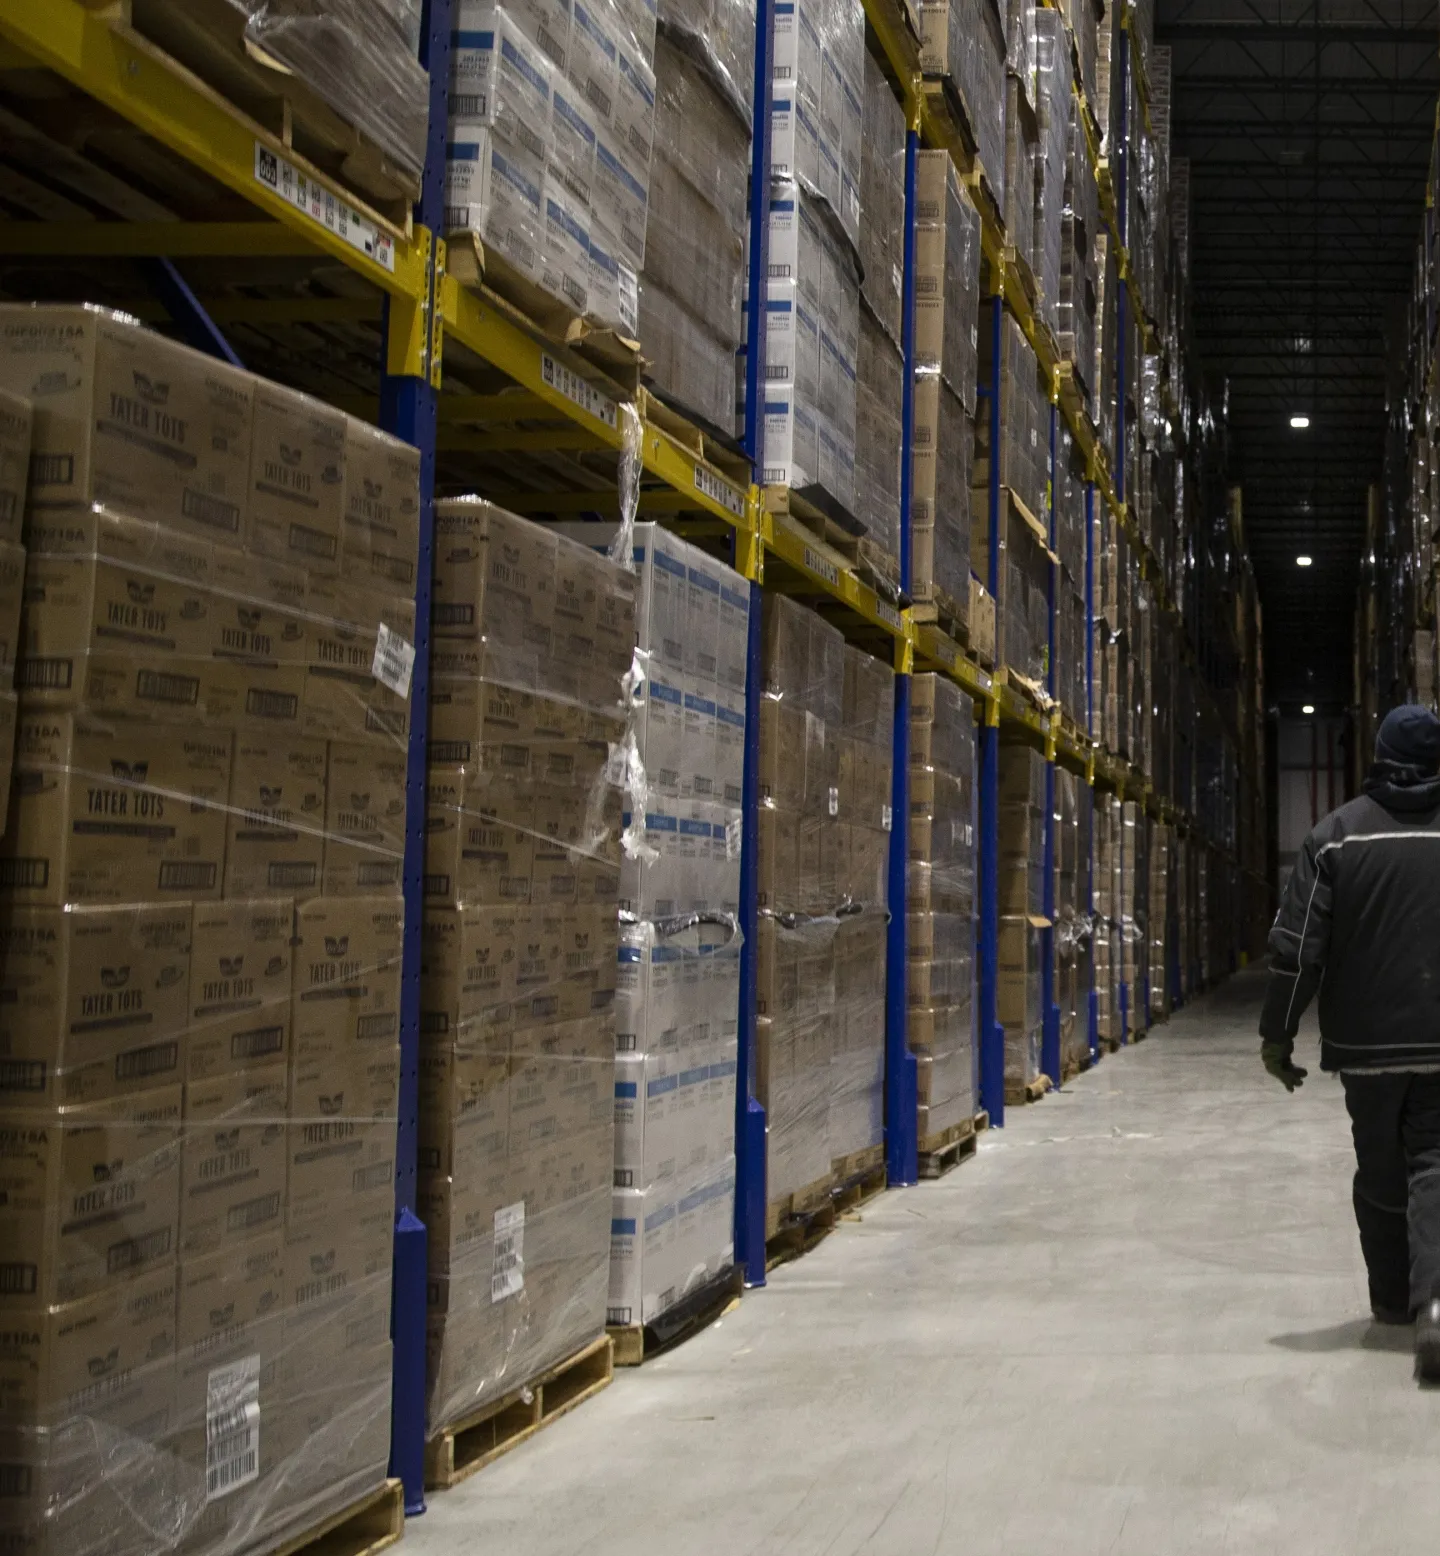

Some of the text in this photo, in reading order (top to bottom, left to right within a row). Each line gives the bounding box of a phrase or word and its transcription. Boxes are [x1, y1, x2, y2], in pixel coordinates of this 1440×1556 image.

[110, 391, 149, 428] TATER
[154, 411, 186, 444] TOTS
[265, 461, 311, 492] TATER TOTS
[108, 601, 167, 632] TATER TOTS
[222, 628, 271, 655] TATER TOTS
[318, 638, 369, 667] TATER TOTS
[87, 788, 165, 819] TATER TOTS
[308, 960, 361, 984] TATER TOTS
[82, 988, 143, 1016] TATER TOTS
[203, 978, 255, 1001] TATER TOTS
[303, 1122, 354, 1145] TATER TOTS
[200, 1149, 250, 1179] TATER TOTS
